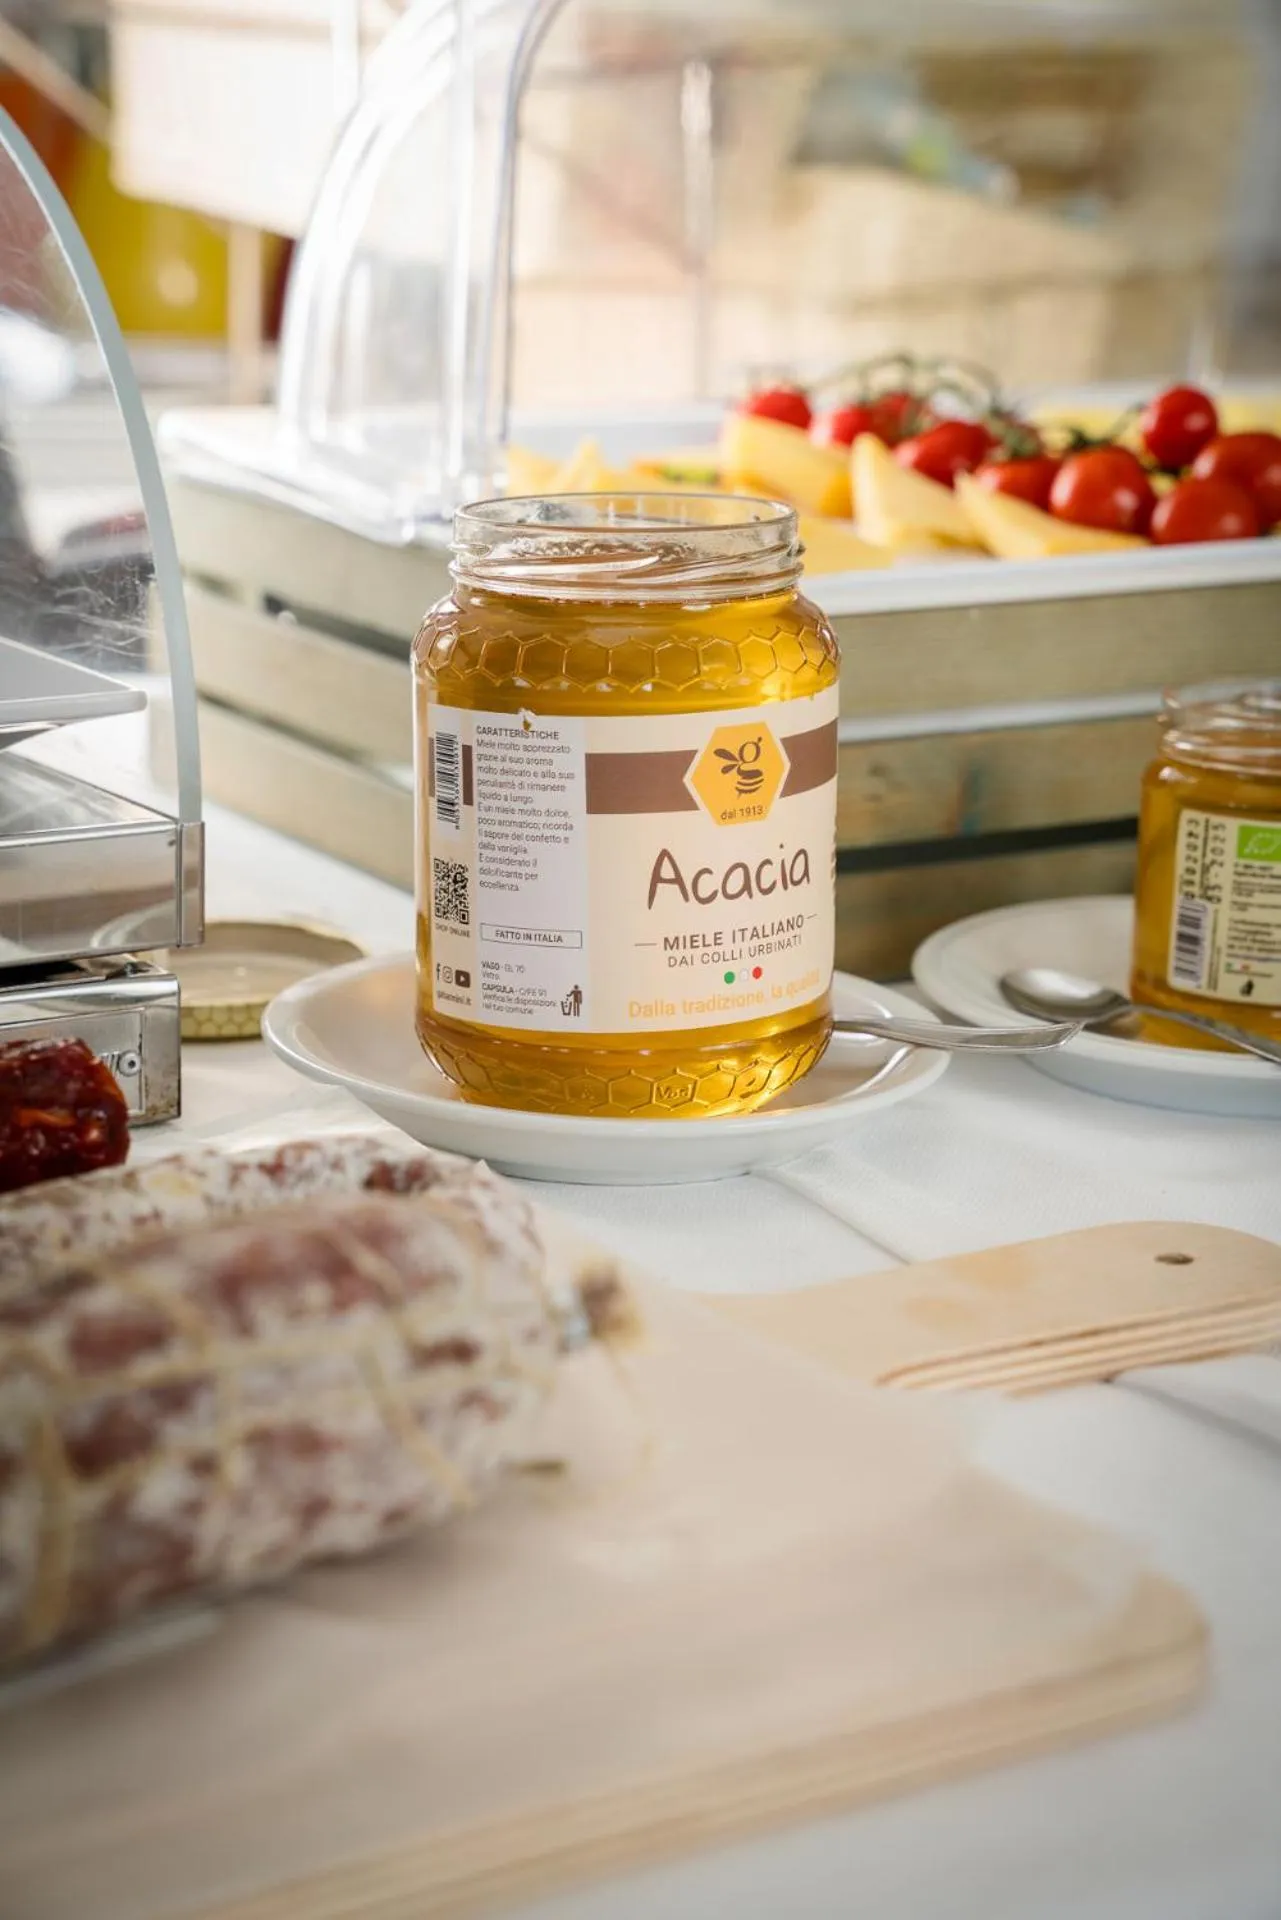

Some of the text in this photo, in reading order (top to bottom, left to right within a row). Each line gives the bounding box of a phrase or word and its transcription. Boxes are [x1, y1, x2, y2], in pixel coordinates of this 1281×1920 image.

[476, 725, 560, 740] CARATTERISTICHE
[476, 738, 571, 754] Miele molto apprezzato
[476, 753, 499, 763] grazie
[508, 756, 524, 765] suo
[525, 757, 554, 767] aroma
[477, 764, 498, 775] molto
[499, 766, 532, 778] delicato
[541, 770, 556, 779] alla
[558, 771, 575, 780] sua
[527, 782, 567, 793] rimanere
[478, 790, 502, 802] liquido
[495, 805, 516, 815] miele
[518, 807, 543, 817] molto
[720, 803, 764, 820] dal 1913
[478, 817, 496, 827] poco
[542, 821, 573, 832] ricorda
[484, 830, 510, 841] sapore
[525, 832, 562, 844] confetto
[485, 855, 531, 868] considerato
[479, 867, 539, 881] dolcificante per
[648, 843, 810, 910] Acacia
[495, 929, 563, 943] FATTO IN ITALIA
[663, 914, 804, 951] MIELE ITALIANO
[668, 934, 801, 968] DAI COLLI URBINATI
[481, 961, 500, 971] VASO
[482, 983, 514, 994] CAPSULA
[628, 998, 675, 1019] Dalla
[771, 983, 783, 999] la
